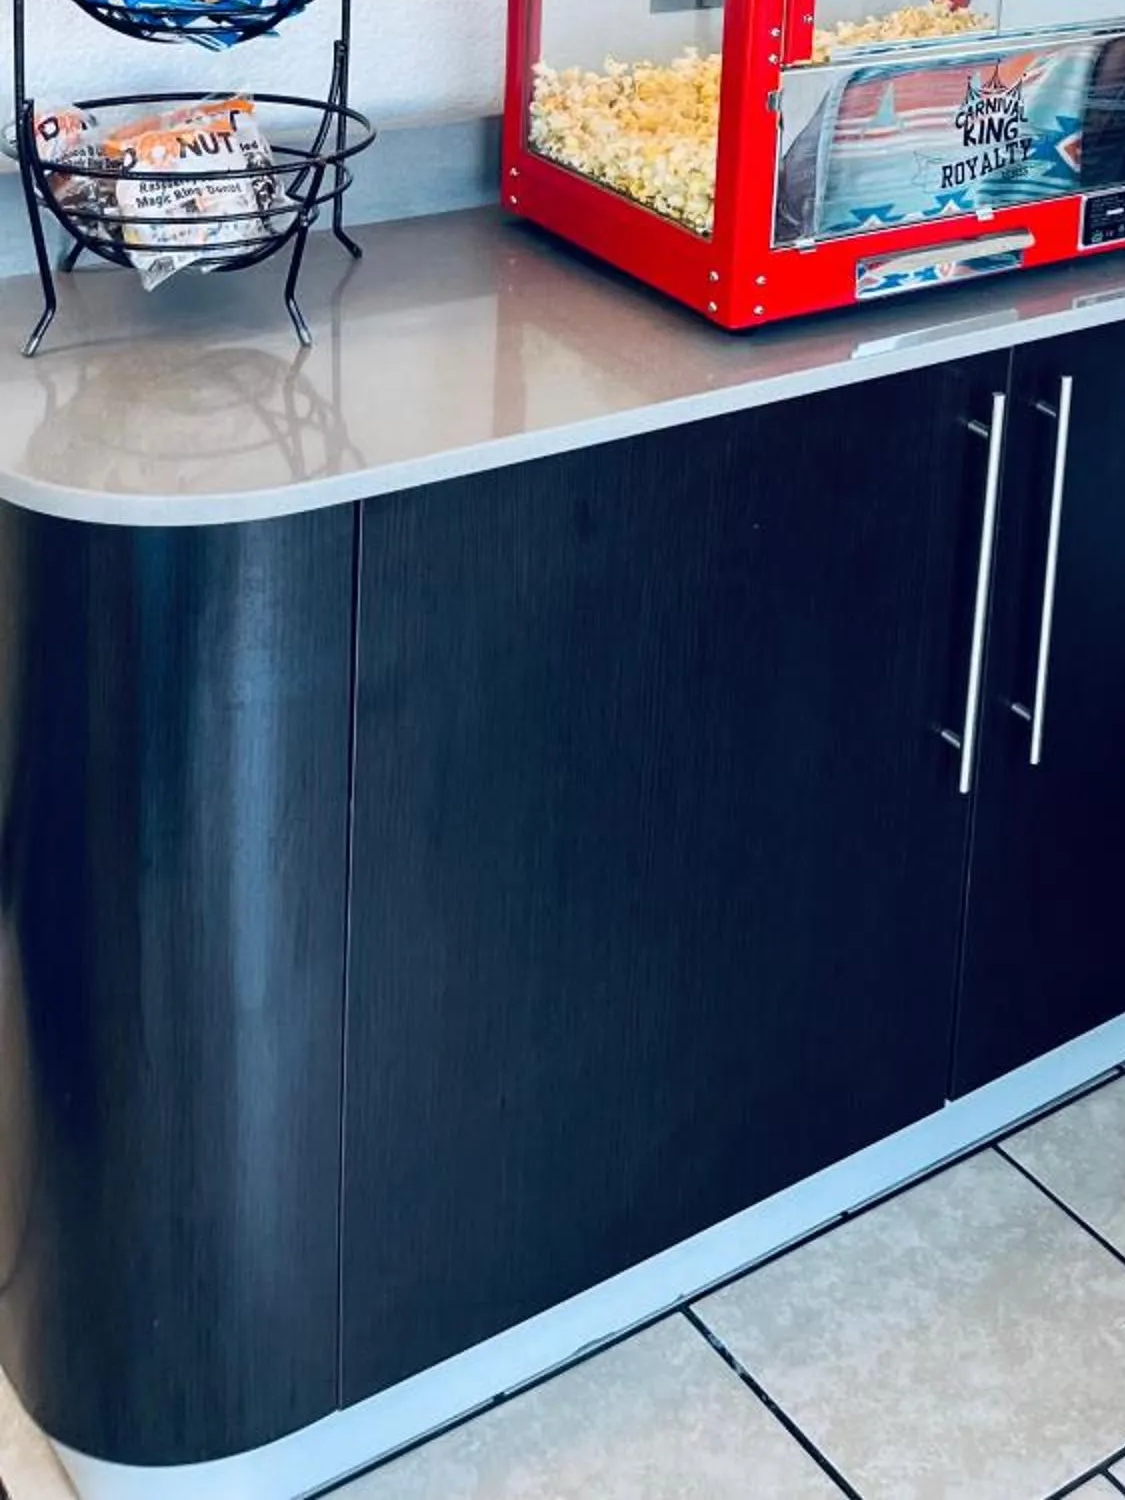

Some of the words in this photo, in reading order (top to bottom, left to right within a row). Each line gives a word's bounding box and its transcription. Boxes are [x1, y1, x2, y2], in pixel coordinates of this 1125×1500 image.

[955, 97, 1028, 129] CARNIVAL
[963, 116, 1019, 147] KING
[940, 137, 1033, 189] ROYALTY
